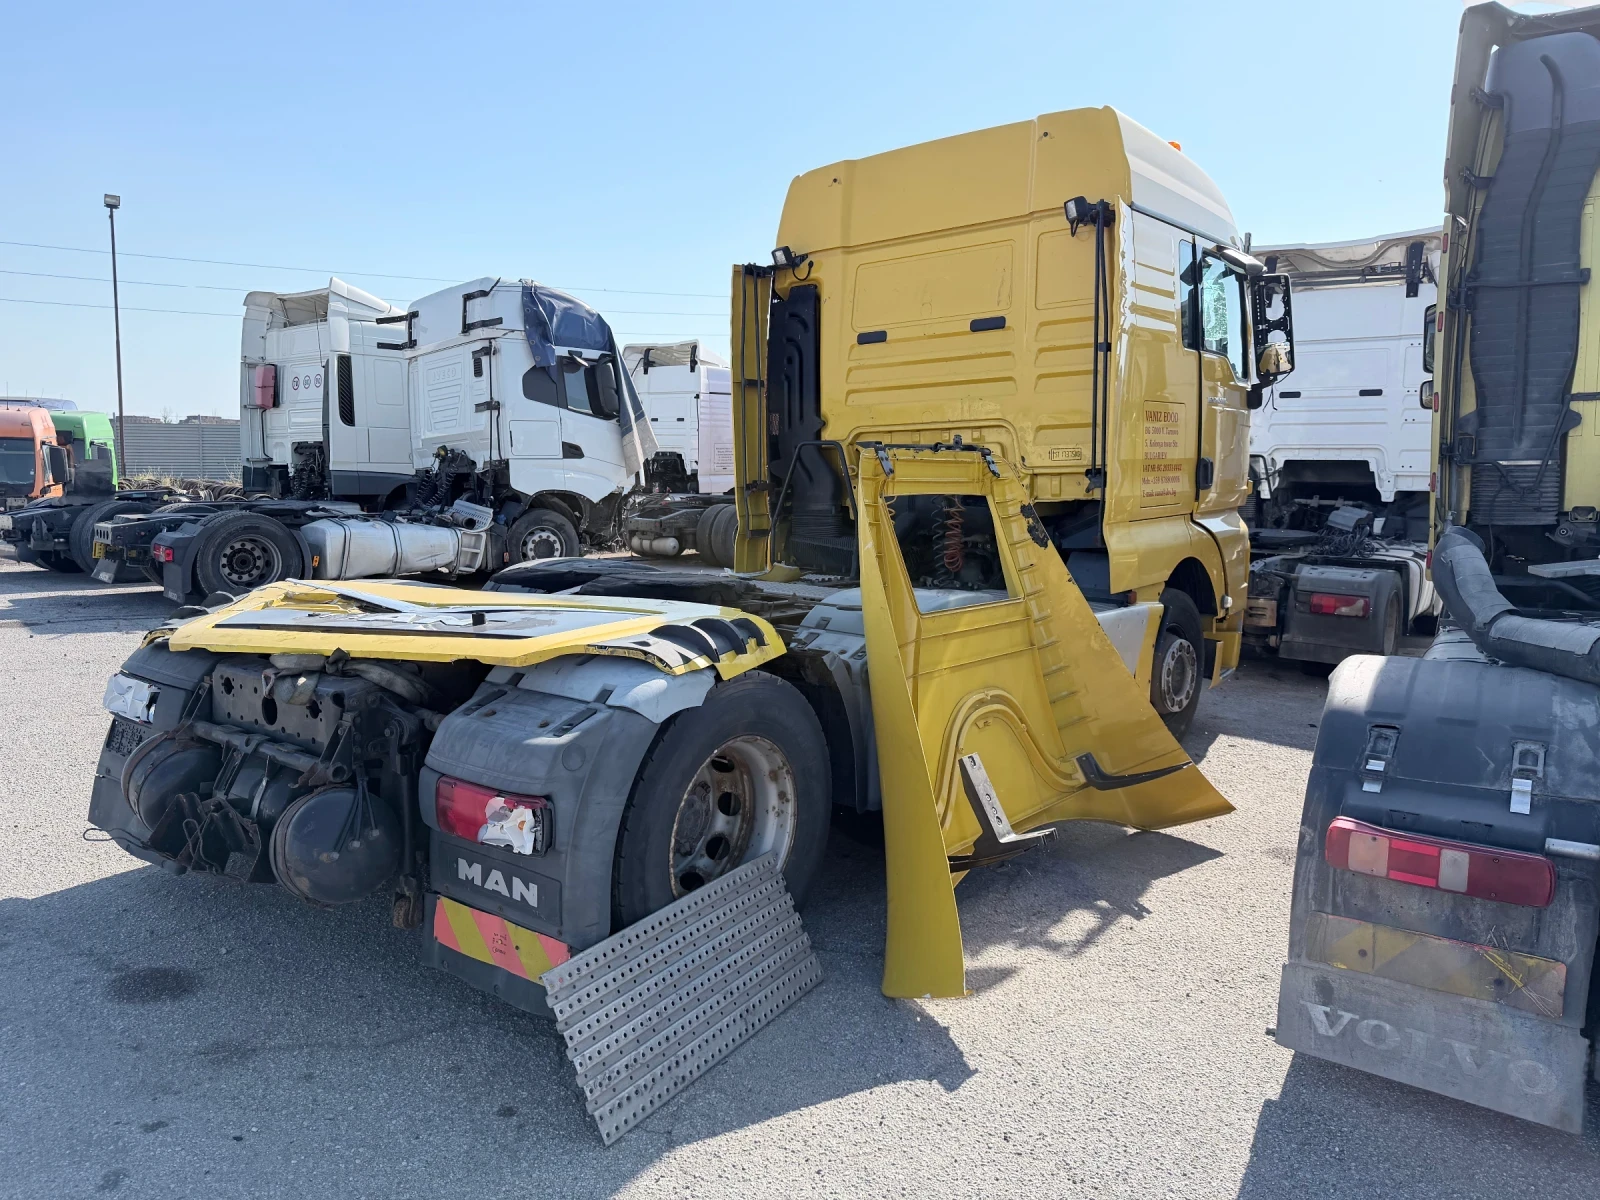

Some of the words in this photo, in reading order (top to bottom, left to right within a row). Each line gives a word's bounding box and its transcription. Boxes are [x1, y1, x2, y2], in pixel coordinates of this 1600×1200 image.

[1145, 410, 1162, 422] VANIZ
[458, 857, 538, 908] MAN
[1300, 1000, 1558, 1095] VOLVO
